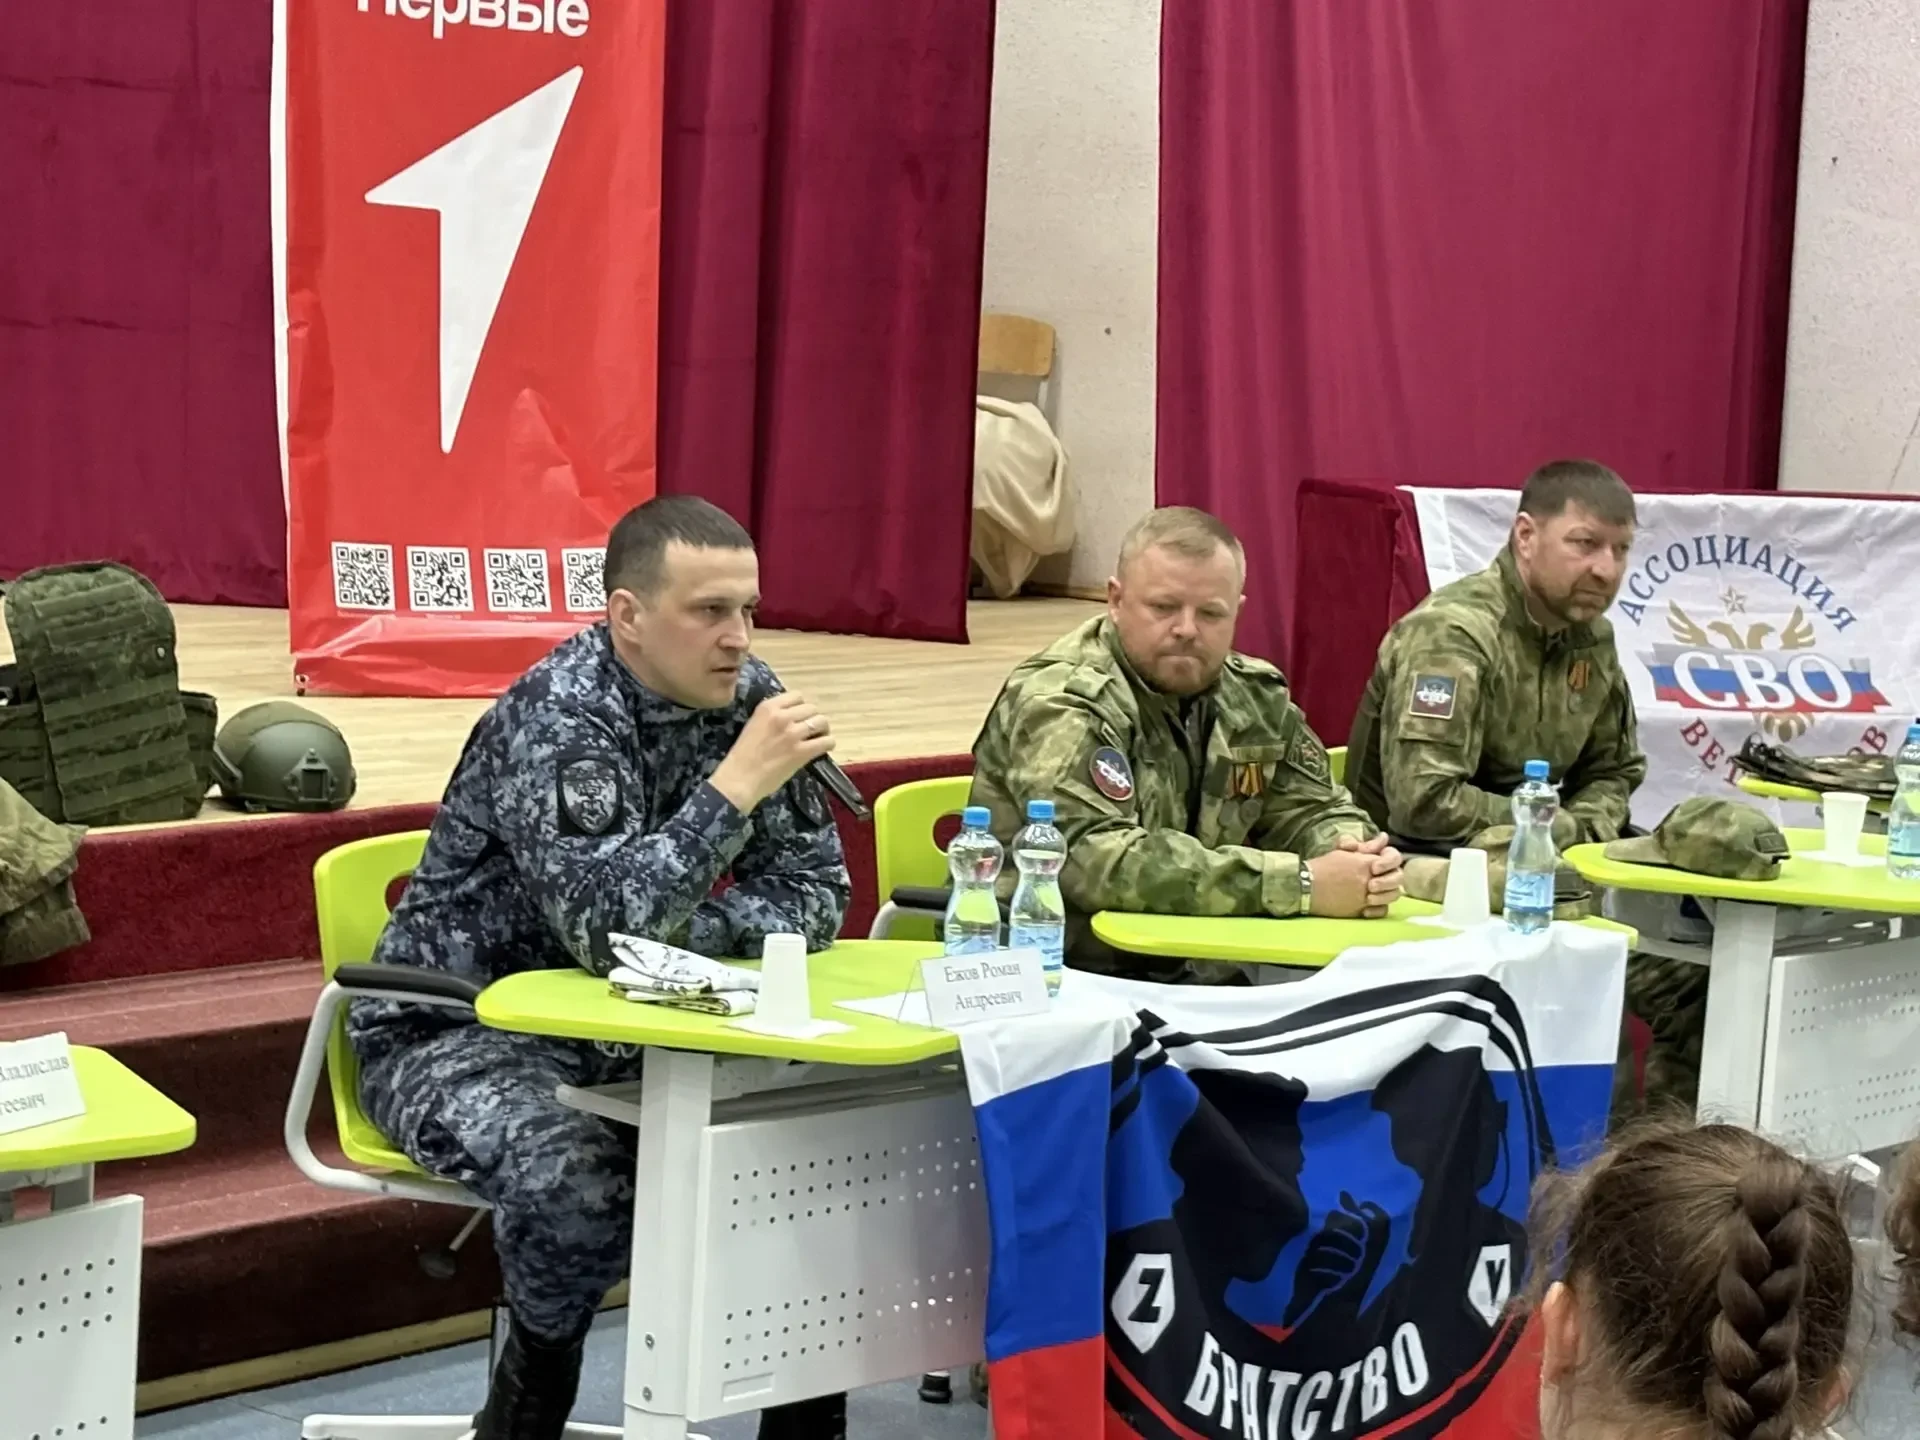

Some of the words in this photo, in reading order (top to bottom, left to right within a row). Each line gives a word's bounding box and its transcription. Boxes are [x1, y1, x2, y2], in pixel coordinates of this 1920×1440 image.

[357, 0, 591, 39] ервые
[1618, 534, 1857, 634] АССОЦИАЦИЯ
[1673, 651, 1853, 710] СВО
[1128, 1268, 1166, 1323] Z
[1183, 1321, 1430, 1440] БРАТСТВО
